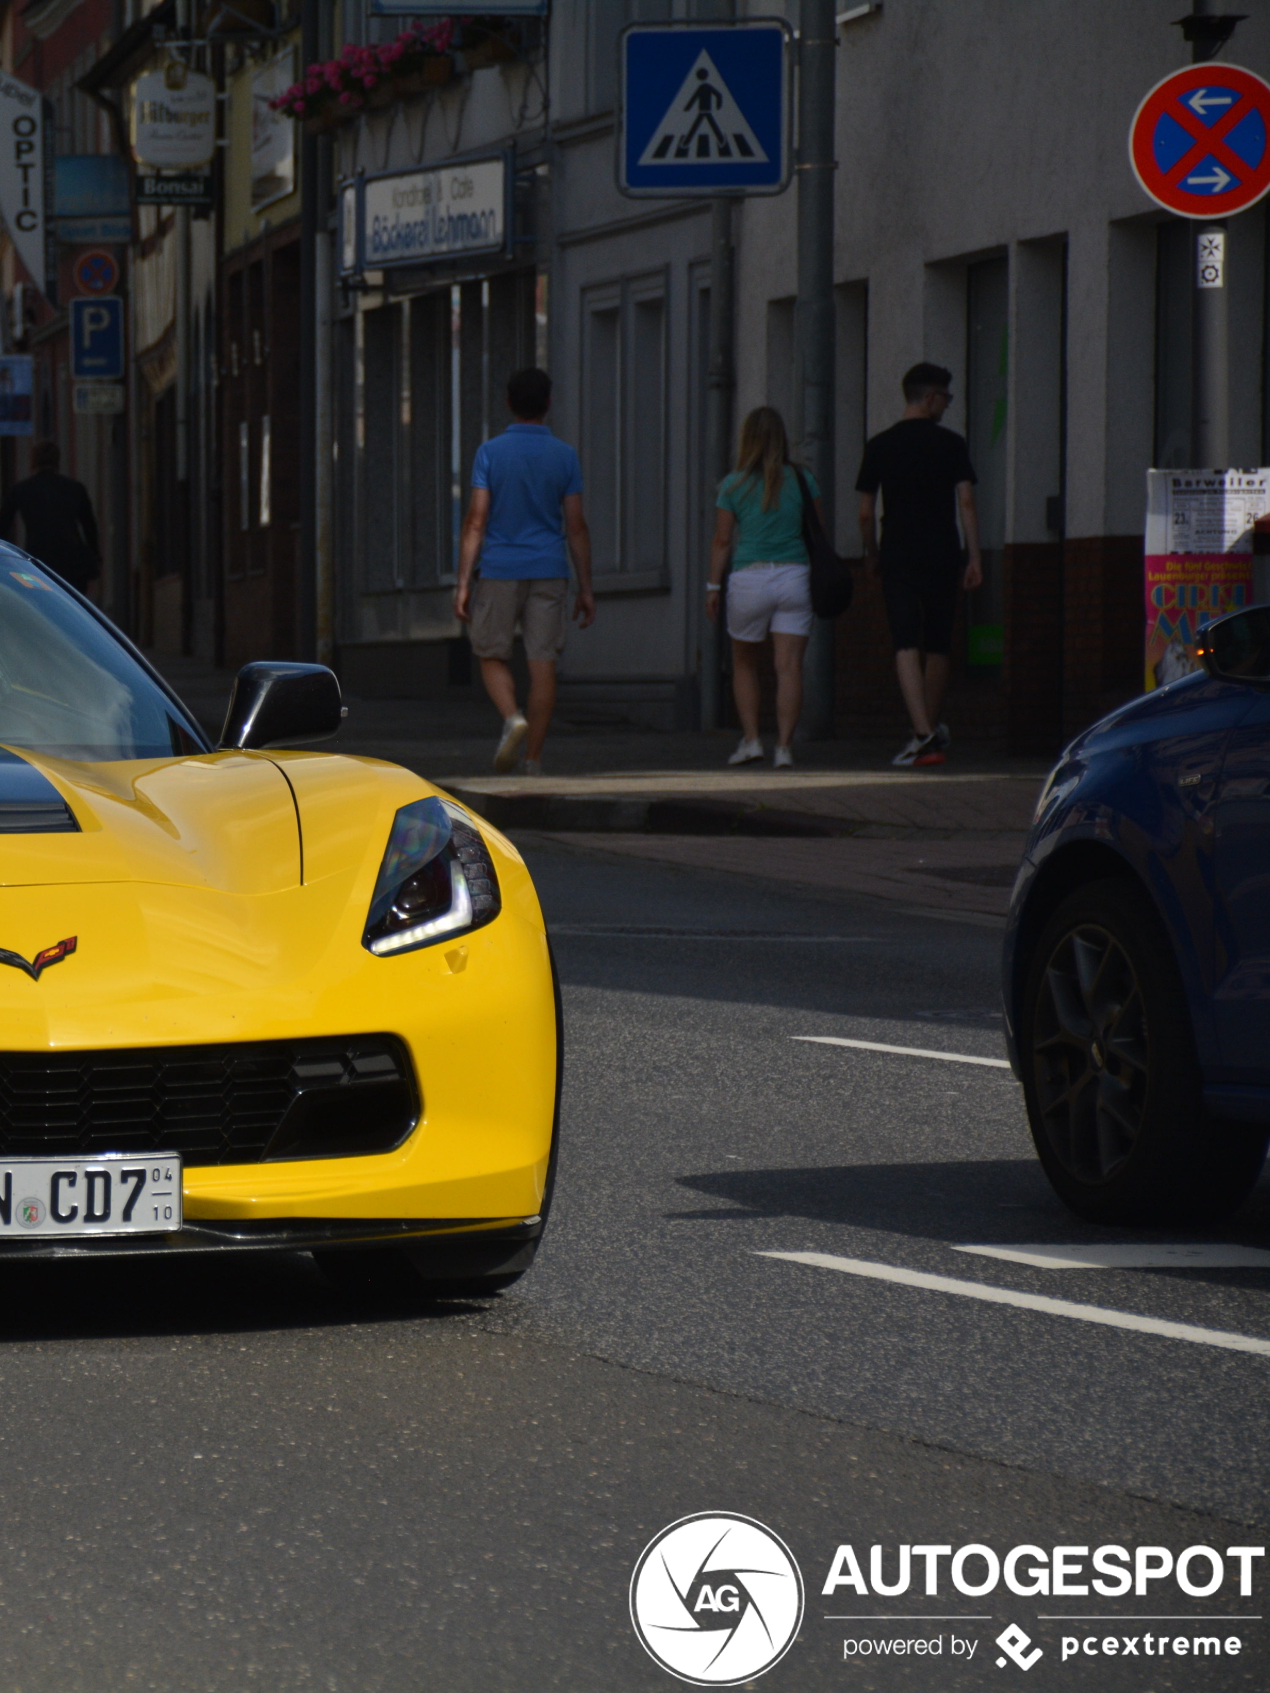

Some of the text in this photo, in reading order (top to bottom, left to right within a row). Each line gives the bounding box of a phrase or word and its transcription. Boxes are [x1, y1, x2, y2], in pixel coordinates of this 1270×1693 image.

[12, 115, 38, 232] OPTIC
[144, 177, 204, 195] Bonsai
[83, 306, 111, 349] P
[1172, 477, 1265, 487] Barweiler
[152, 1167, 173, 1182] 04
[50, 1167, 147, 1225] CD7
[153, 1205, 173, 1221] 10
